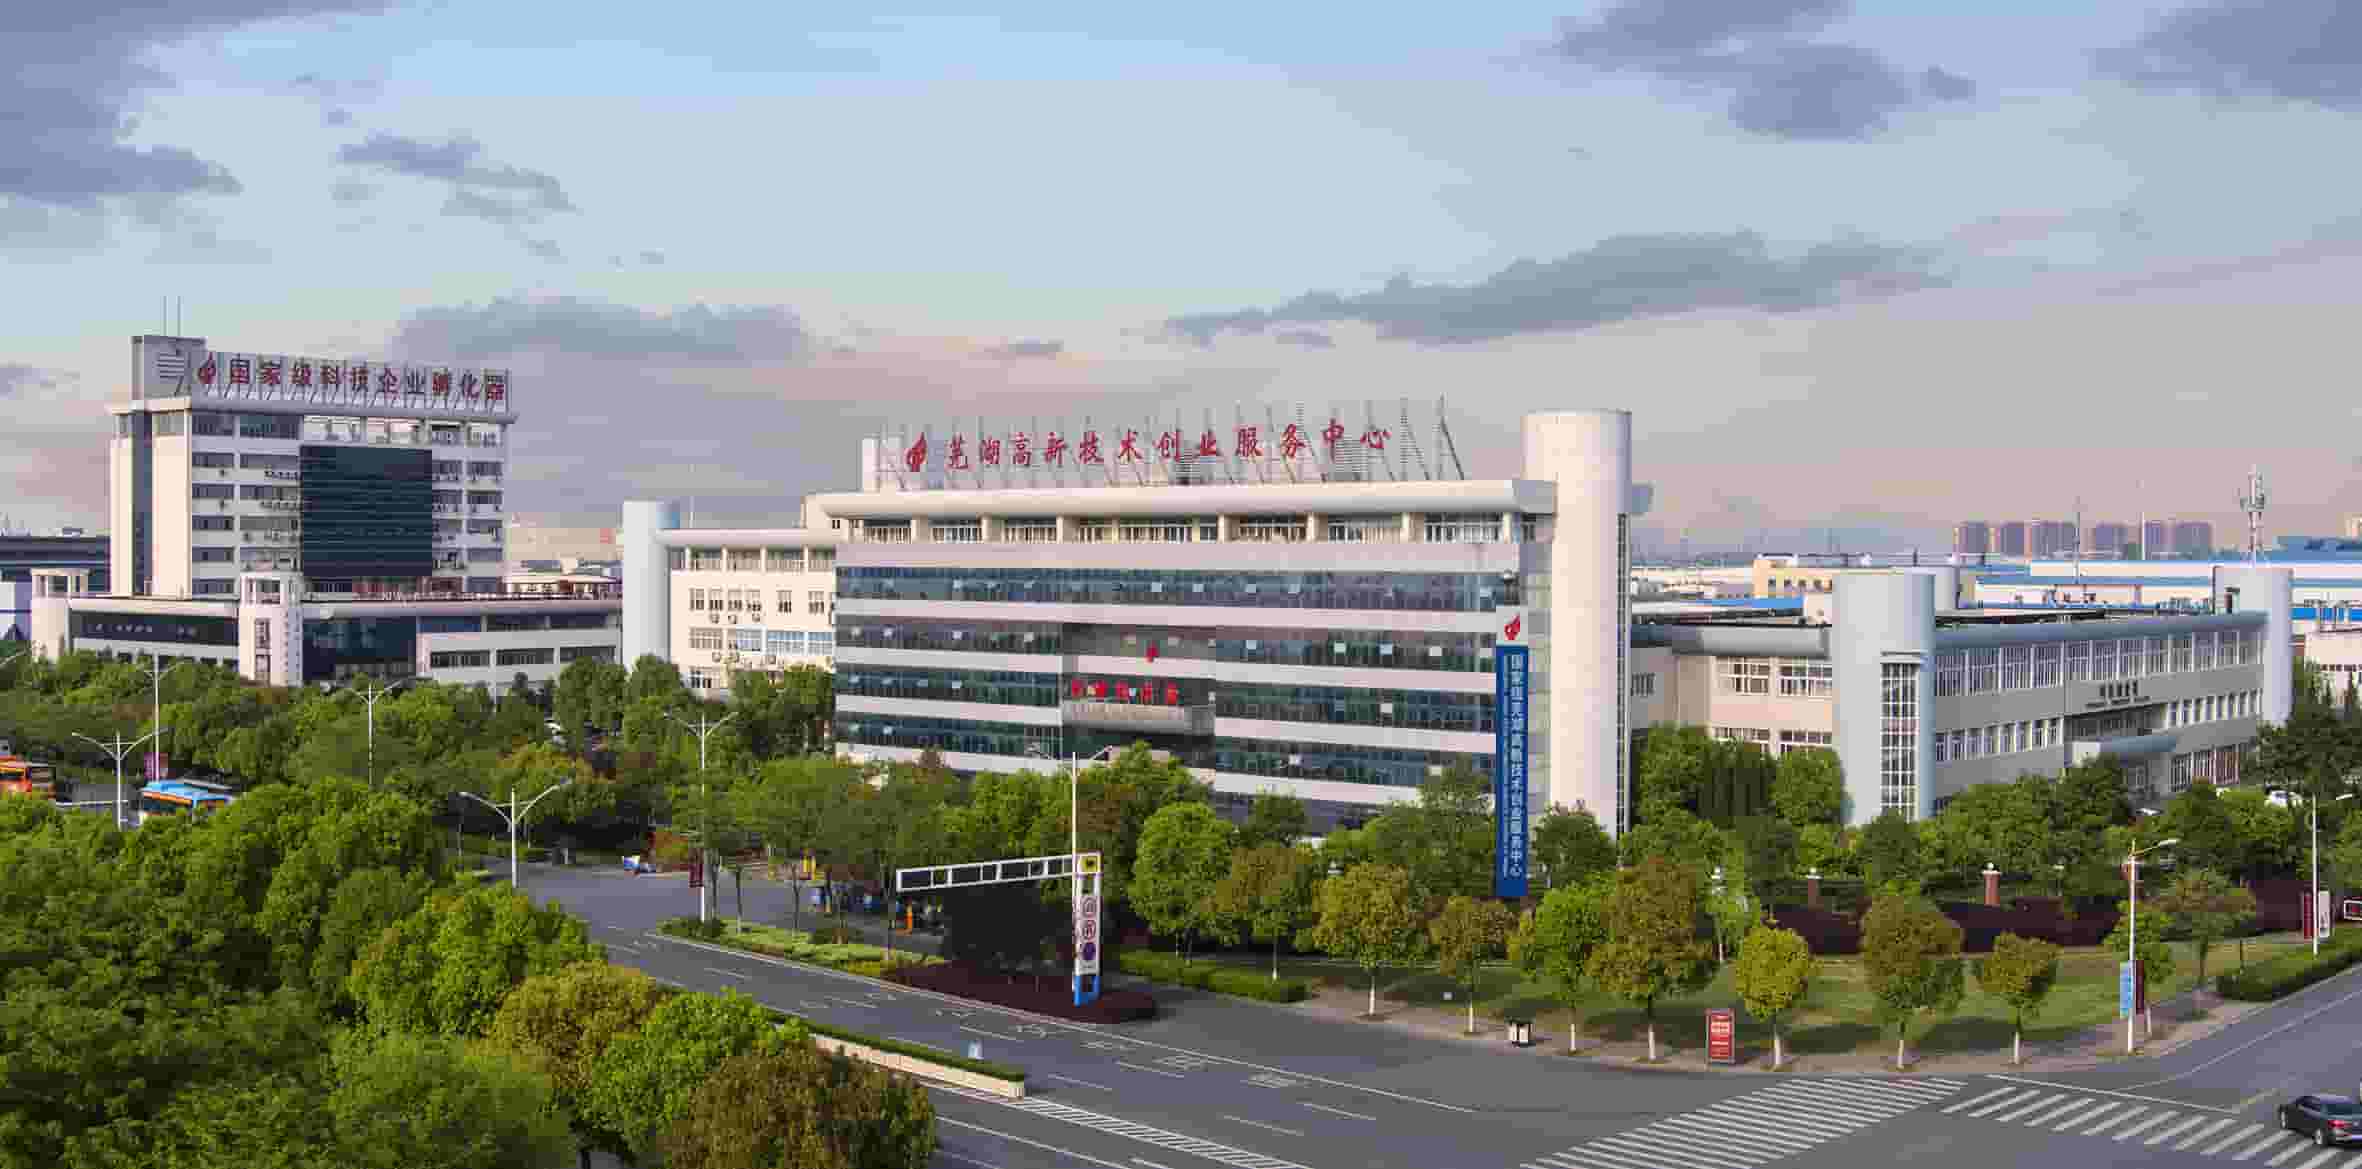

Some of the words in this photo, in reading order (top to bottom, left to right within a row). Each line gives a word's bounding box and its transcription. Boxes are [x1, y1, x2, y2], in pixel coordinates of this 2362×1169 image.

[229, 352, 505, 400] 国家级科技企业孵化器
[946, 419, 1392, 471] 芜湖高新技术创业服务中心
